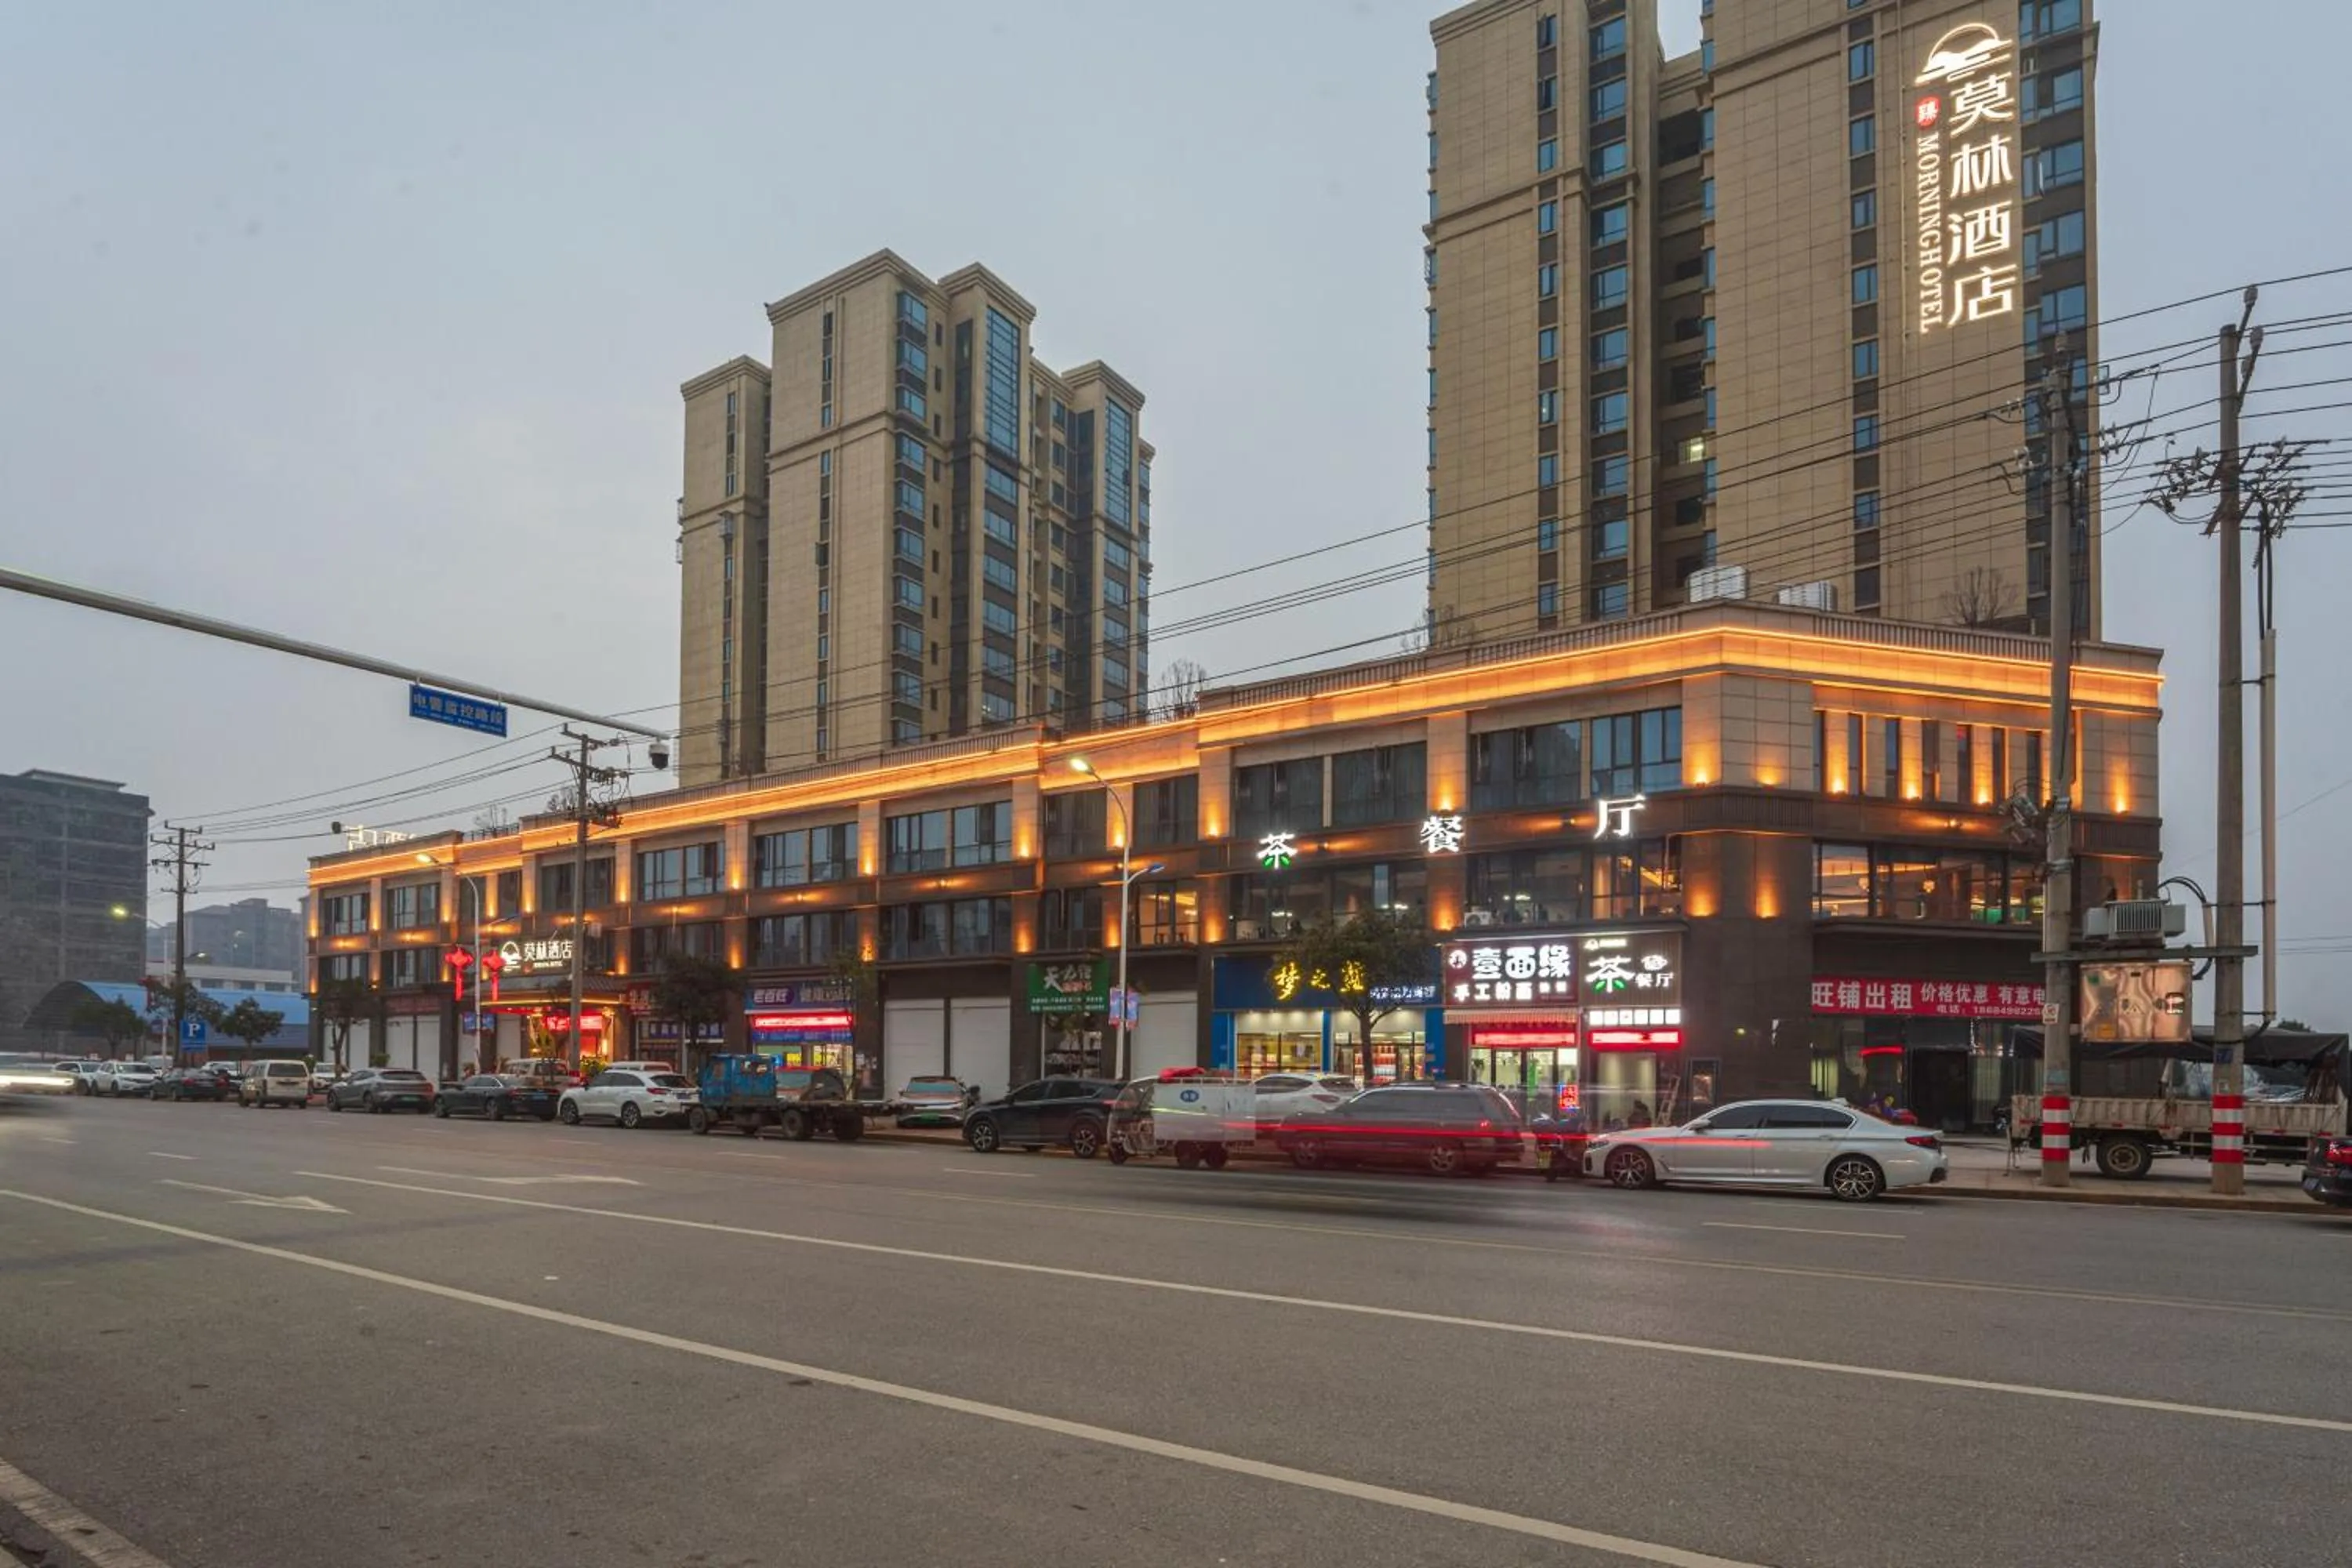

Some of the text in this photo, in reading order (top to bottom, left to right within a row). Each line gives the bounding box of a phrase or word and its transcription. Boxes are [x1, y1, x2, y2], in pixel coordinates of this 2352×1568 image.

[1947, 71, 2019, 329] 莫林酒店
[524, 939, 573, 962] 莫林酒店
[1811, 981, 1913, 1009] 旺铺出租
[1921, 982, 1988, 1004] 价格优惠
[189, 1023, 201, 1036] P
